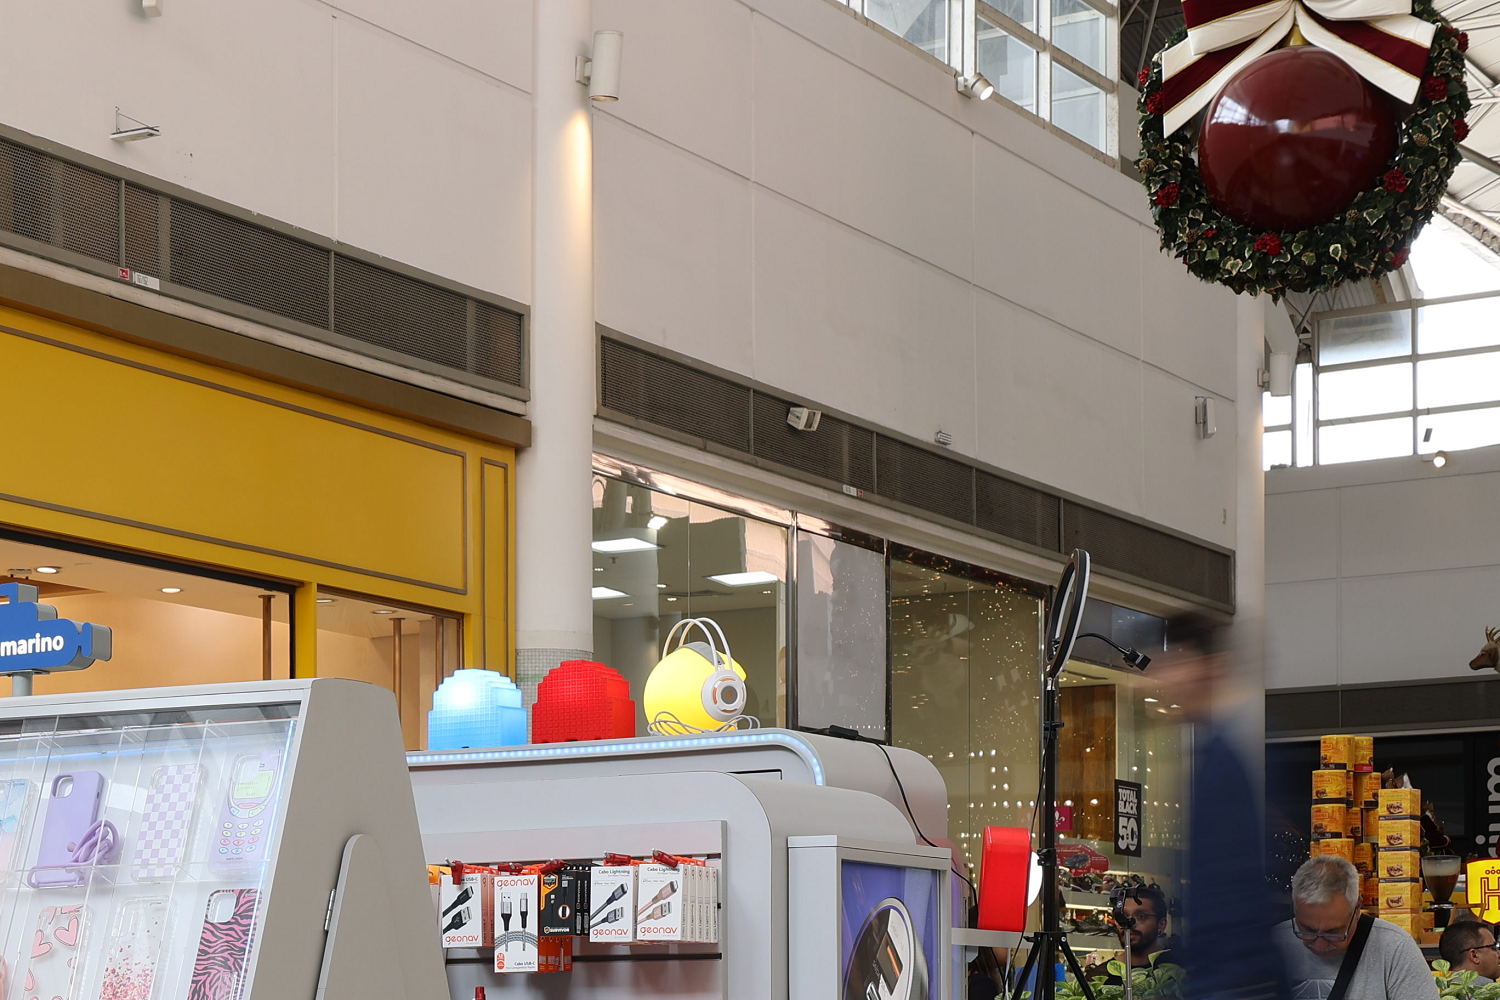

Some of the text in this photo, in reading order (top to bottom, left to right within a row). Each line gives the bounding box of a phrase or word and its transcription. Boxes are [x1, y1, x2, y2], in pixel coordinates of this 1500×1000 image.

[1118, 788, 1138, 802] TOTAL
[1118, 801, 1138, 815] BLACK
[496, 877, 536, 890] geonav
[592, 928, 629, 938] geonav
[639, 926, 678, 936] geonav
[445, 935, 479, 945] geonav
